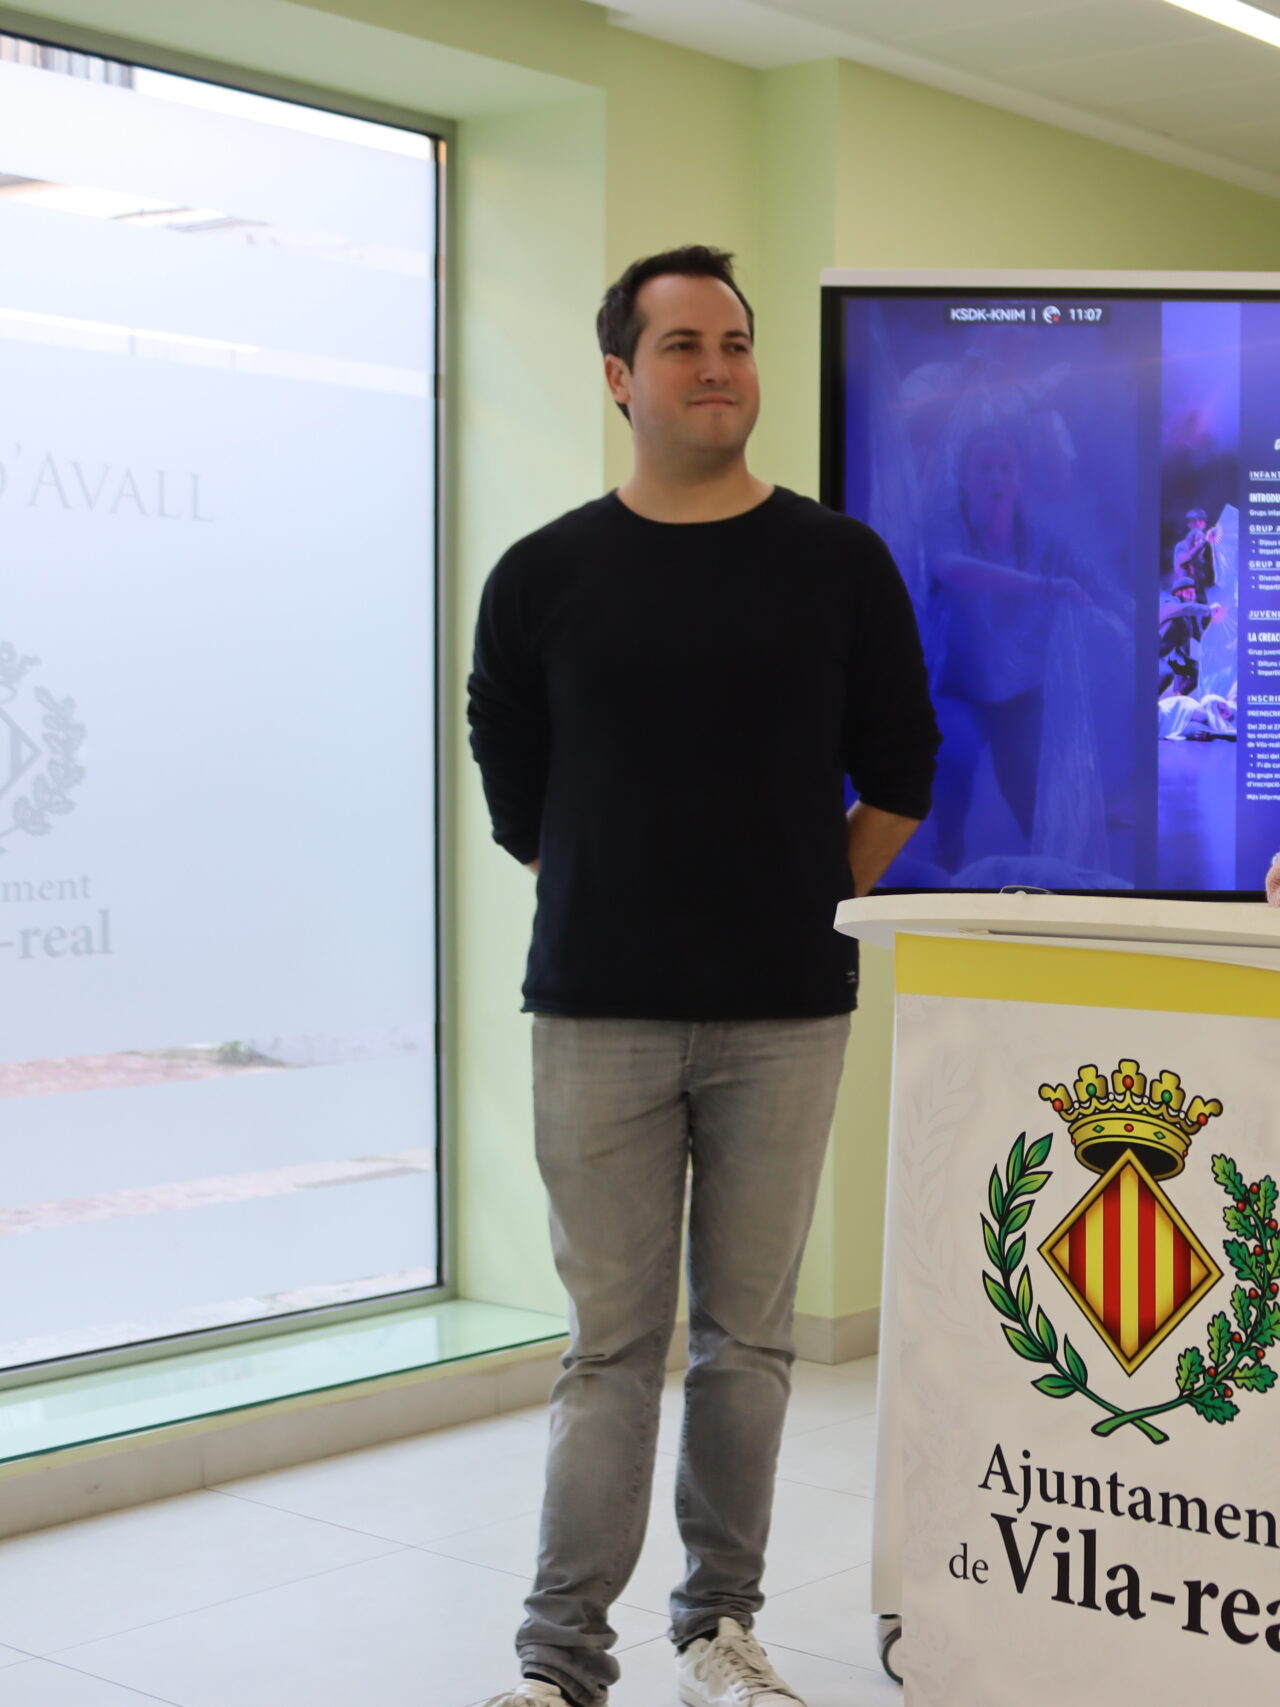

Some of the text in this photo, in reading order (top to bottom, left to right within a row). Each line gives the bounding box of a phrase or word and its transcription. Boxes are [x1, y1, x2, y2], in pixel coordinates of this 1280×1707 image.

[951, 308, 1026, 321] KSDK-KNIM
[1069, 308, 1103, 321] 11:07
[1249, 525, 1273, 533] GRUP
[1248, 632, 1257, 642] LA
[948, 1542, 990, 1585] de
